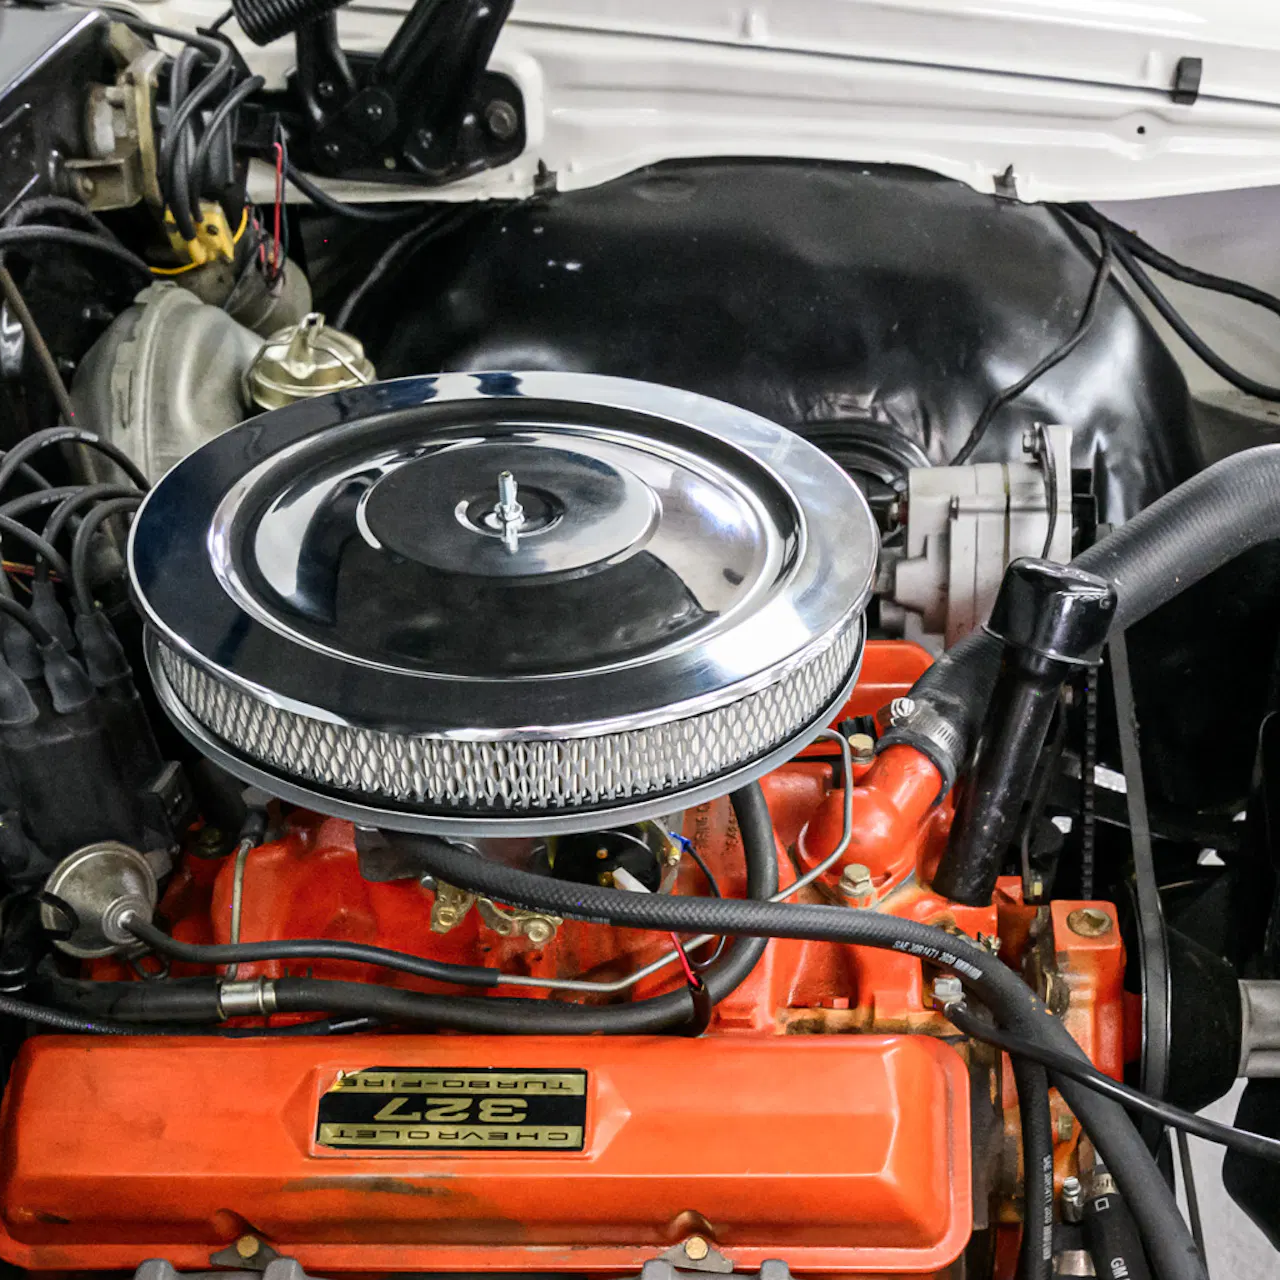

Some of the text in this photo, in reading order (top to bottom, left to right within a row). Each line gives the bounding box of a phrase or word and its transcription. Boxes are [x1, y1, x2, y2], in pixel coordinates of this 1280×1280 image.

[342, 1078, 573, 1091] TURBO-FIRE
[374, 1097, 529, 1123] 327
[333, 1129, 569, 1142] CHEVROLET
[1110, 1256, 1129, 1279] GM
